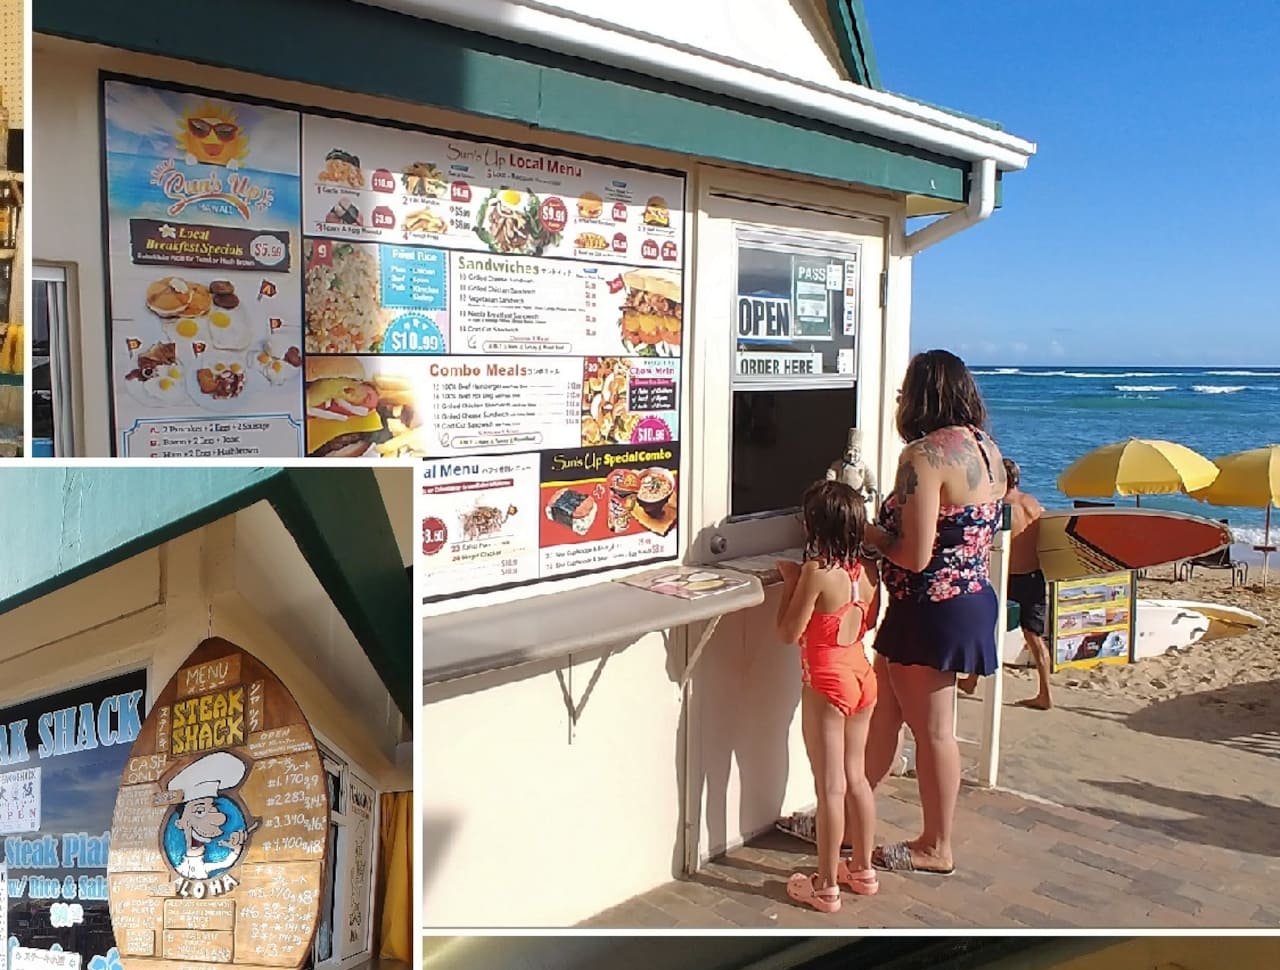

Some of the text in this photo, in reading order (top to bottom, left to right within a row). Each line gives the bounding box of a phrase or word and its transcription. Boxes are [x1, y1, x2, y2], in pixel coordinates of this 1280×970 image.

[484, 147, 506, 169] Up
[509, 153, 544, 171] Local
[547, 157, 582, 178] Menu
[227, 173, 260, 205] Up
[178, 227, 210, 240] Local
[146, 239, 244, 257] Breakfast Specials
[317, 244, 327, 257] 9
[457, 256, 540, 275] Sandwiches
[798, 266, 826, 281] PASS
[738, 298, 790, 337] OPEN
[391, 331, 439, 351] $10.99
[429, 363, 481, 377] Combo
[486, 363, 527, 377] Meals
[740, 358, 814, 375] ORDER HERE
[584, 453, 602, 470] Up
[603, 451, 638, 467] Special
[638, 449, 672, 463] Combo
[440, 463, 480, 479] Menu
[185, 661, 229, 687] MENU
[173, 687, 244, 729] STEAK
[37, 688, 144, 760] SHACK
[172, 716, 244, 755] SHACK
[129, 754, 167, 772] CASH
[128, 769, 163, 785] ONLY
[5, 834, 60, 870] Steak
[7, 876, 28, 898] w/
[28, 875, 60, 899] Rice
[61, 875, 77, 899] &
[174, 874, 240, 899] ALOHA
